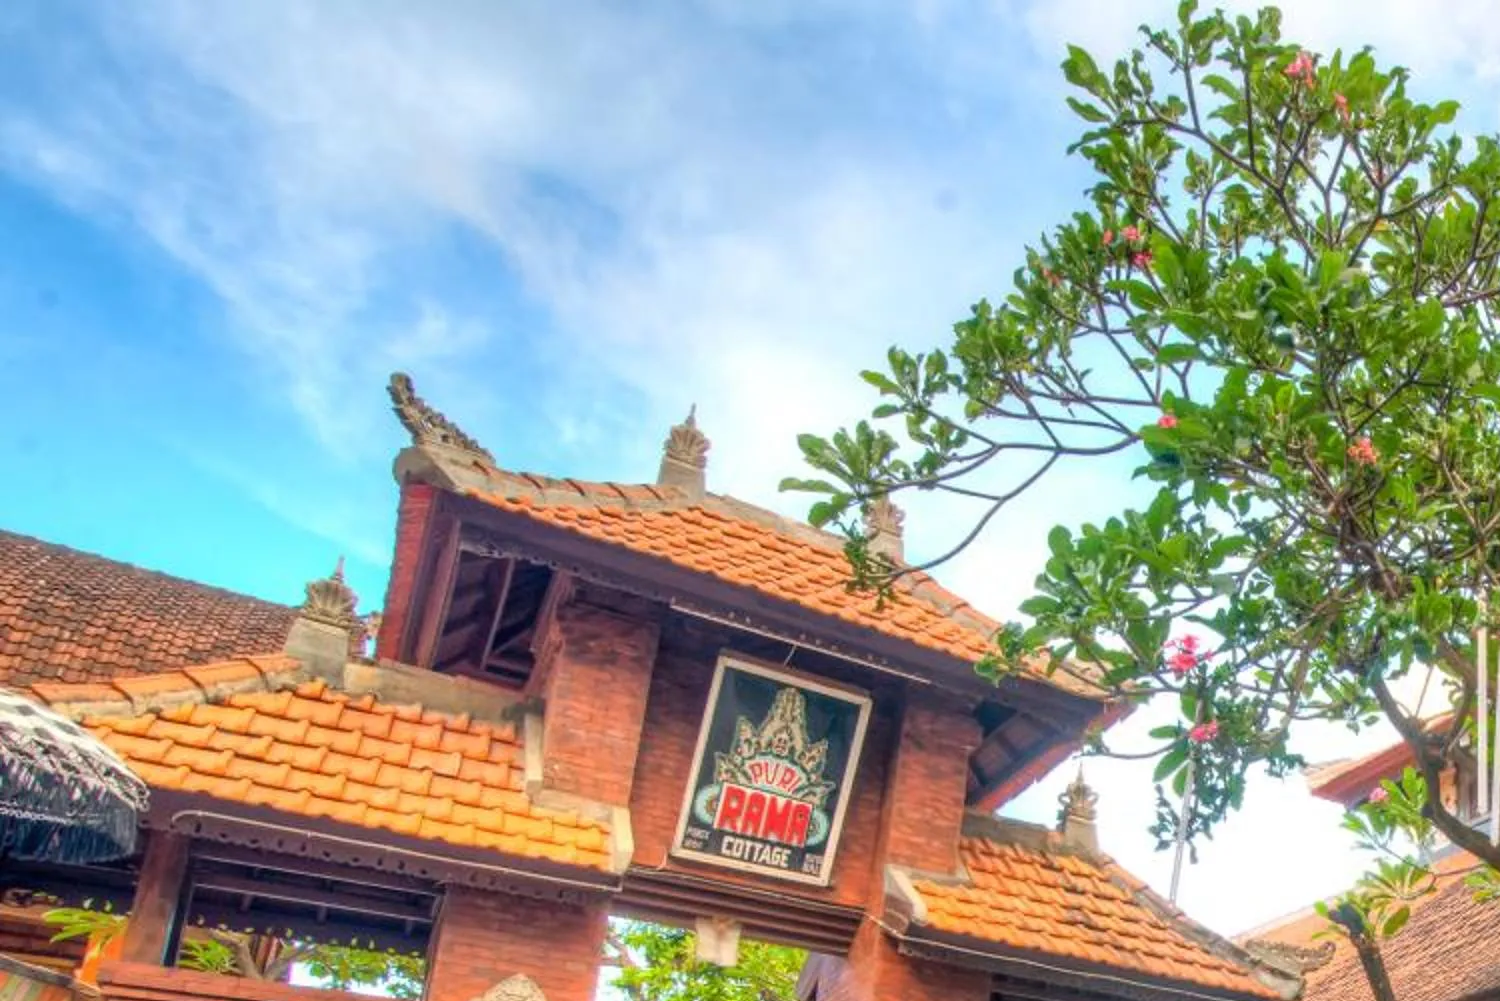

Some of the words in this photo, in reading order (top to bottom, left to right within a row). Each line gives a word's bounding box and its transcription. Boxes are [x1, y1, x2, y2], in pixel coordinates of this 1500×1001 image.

[749, 761, 801, 792] PURI
[717, 785, 811, 846] RAMA
[721, 836, 792, 867] COTTAGE
